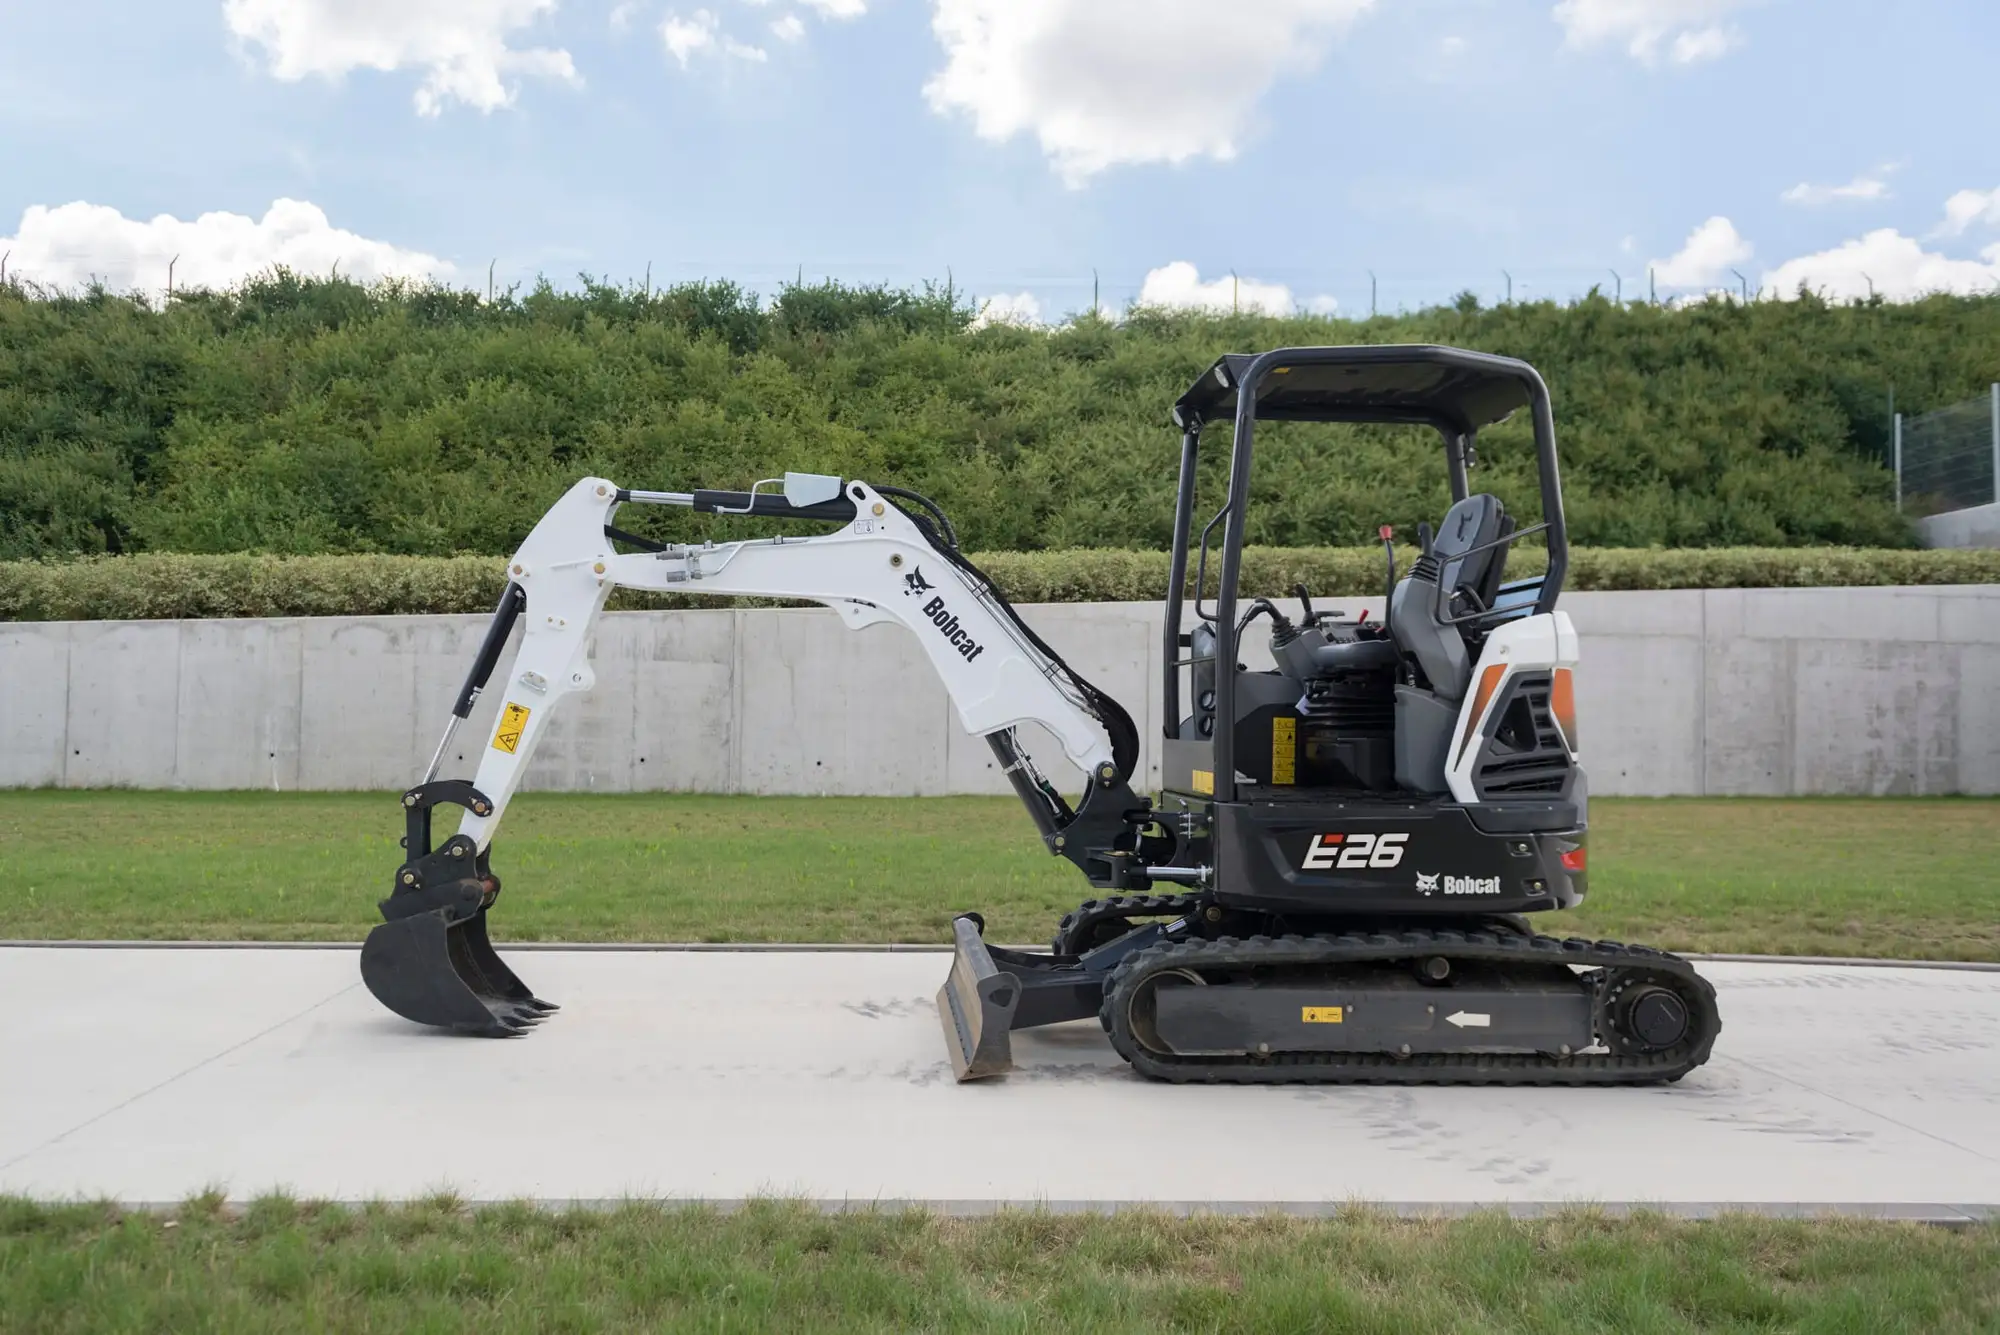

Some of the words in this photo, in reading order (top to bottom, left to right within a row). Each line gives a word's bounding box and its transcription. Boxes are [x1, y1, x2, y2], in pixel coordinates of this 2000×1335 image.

[922, 595, 984, 663] Bobcat
[1302, 833, 1410, 869] E26
[1444, 876, 1501, 894] Bobcat
